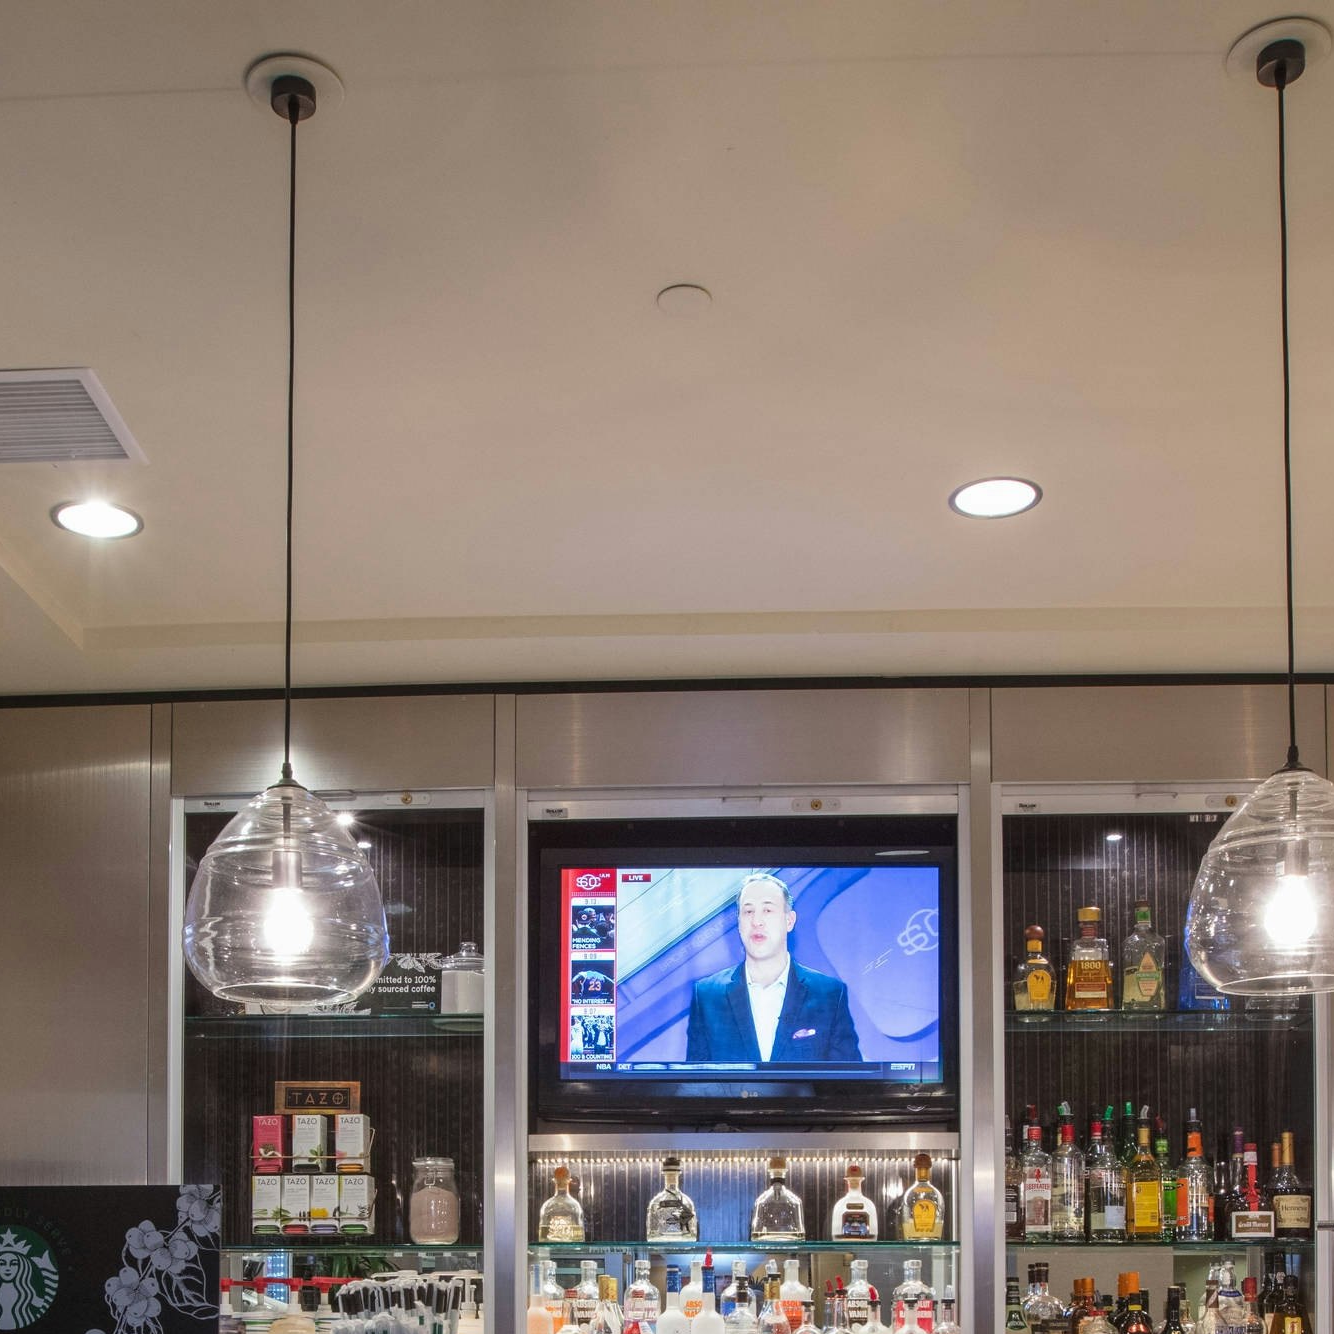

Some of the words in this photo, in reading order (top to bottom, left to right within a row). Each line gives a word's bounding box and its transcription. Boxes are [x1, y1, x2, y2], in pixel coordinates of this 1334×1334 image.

[1081, 961, 1101, 969] 1800
[404, 976, 413, 984] to
[414, 975, 436, 984] 100%
[378, 985, 409, 993] sourced
[411, 985, 436, 993] coffee
[588, 981, 602, 991] 23
[890, 1063, 916, 1071] ESPN
[291, 1092, 345, 1105] TAZO
[258, 1118, 278, 1126] TAZO
[257, 1178, 277, 1186] TAZO
